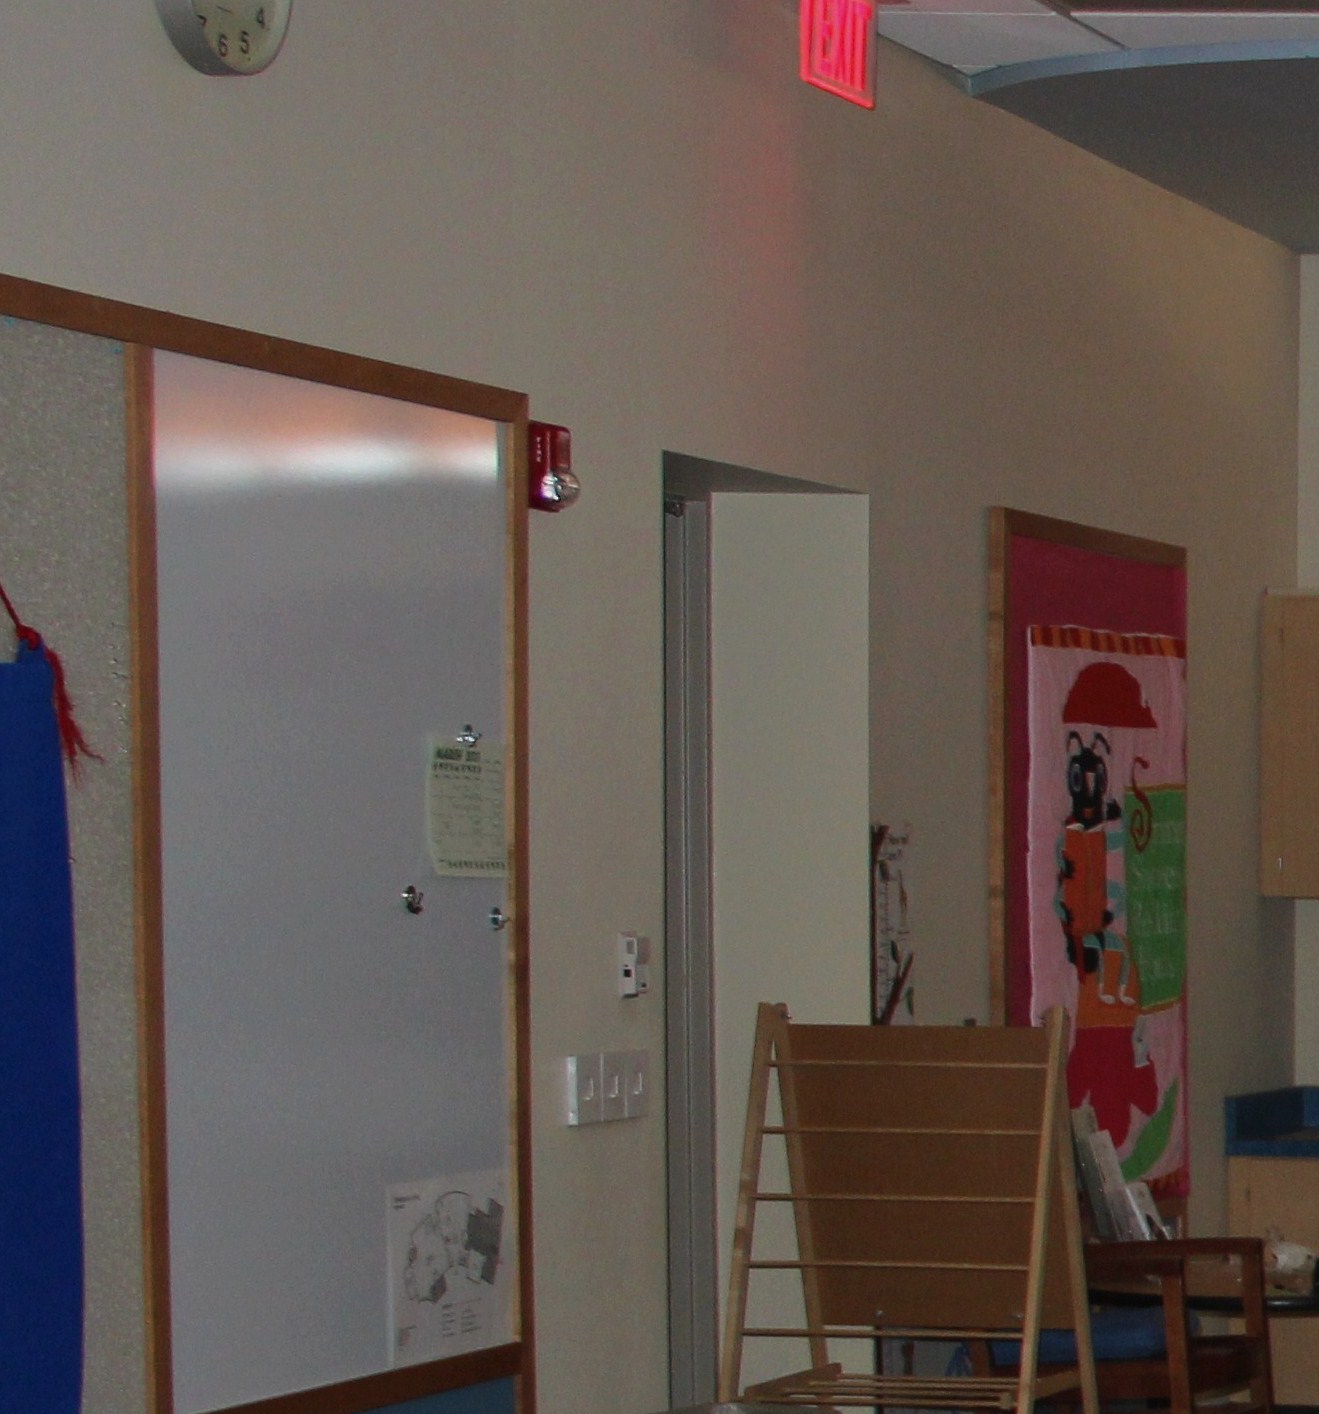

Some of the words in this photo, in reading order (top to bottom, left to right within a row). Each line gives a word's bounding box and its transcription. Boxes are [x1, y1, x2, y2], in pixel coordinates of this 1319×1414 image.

[218, 33, 229, 57] 6
[240, 30, 250, 54] 5
[813, 0, 872, 92] EXIT
